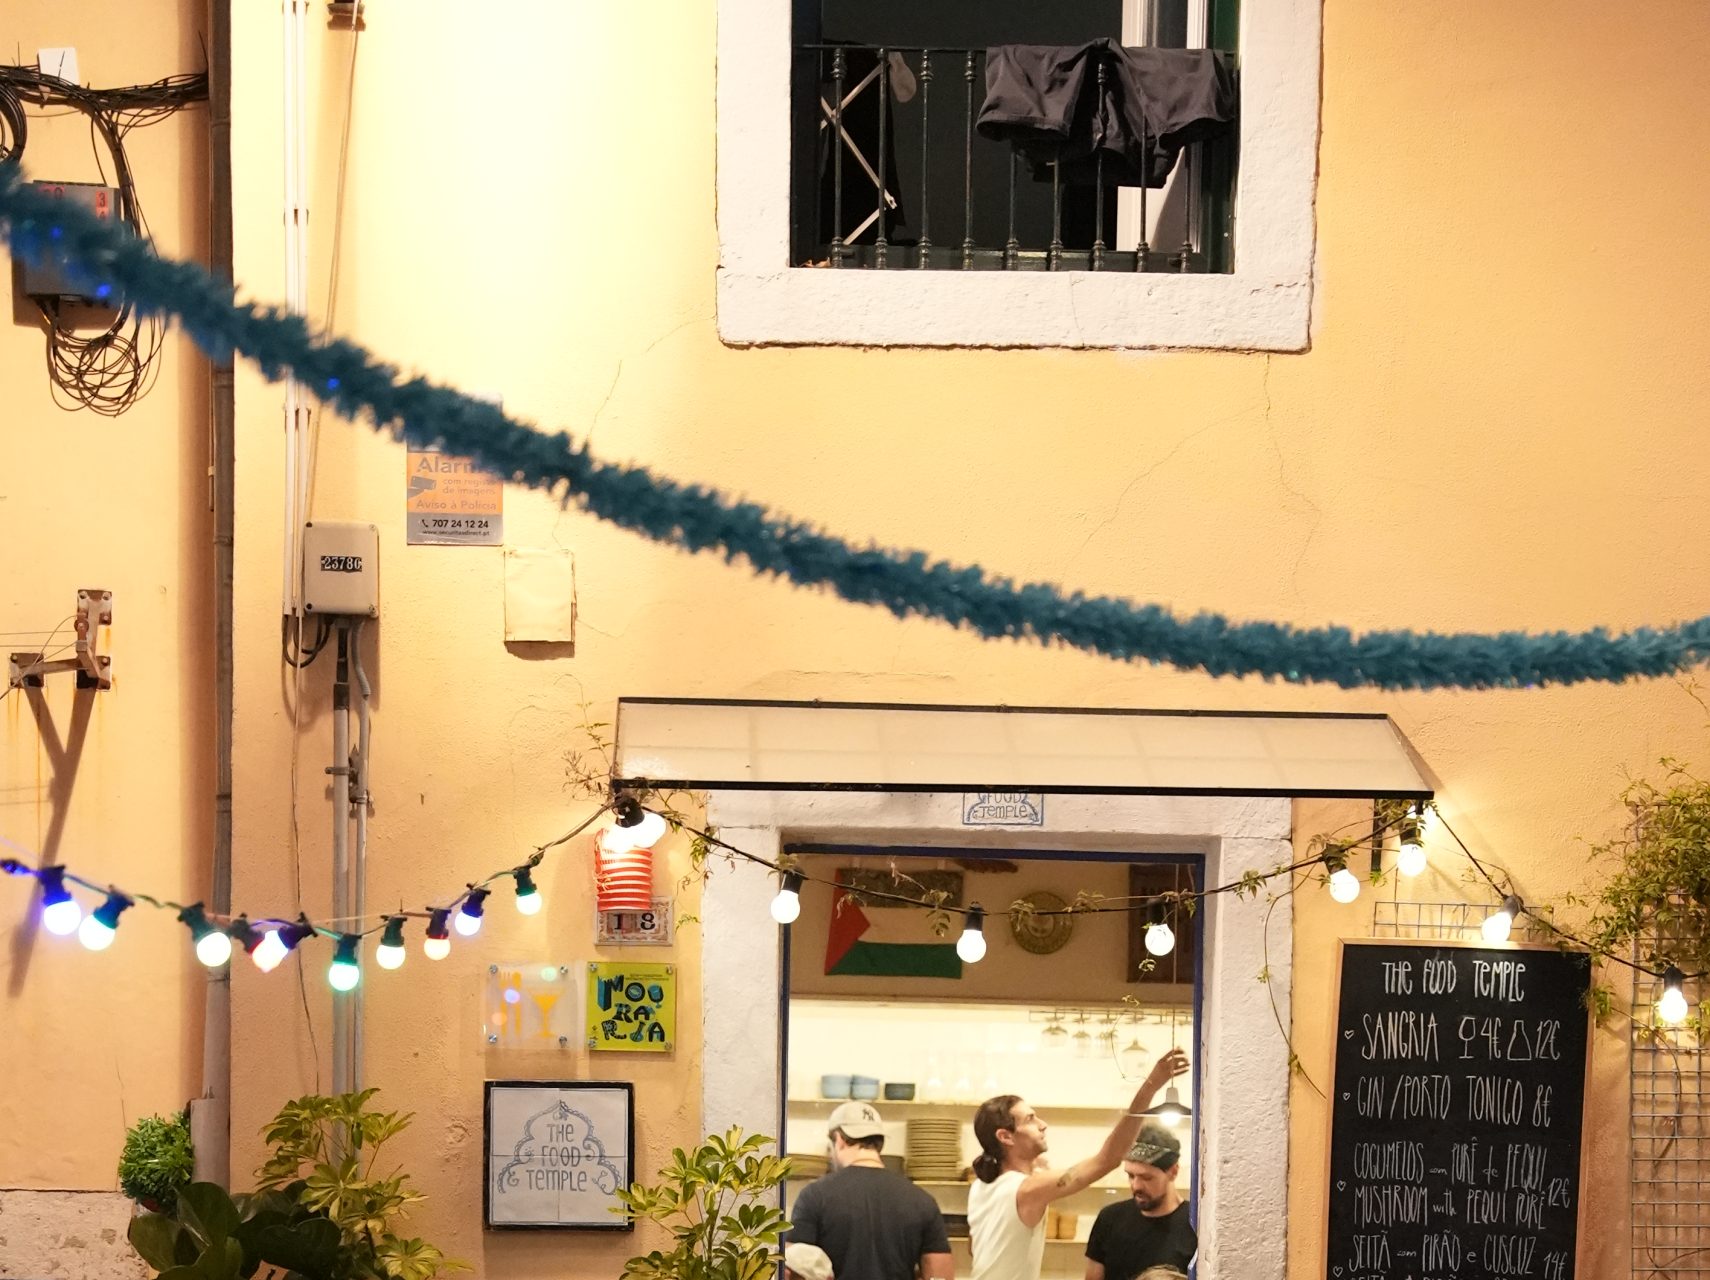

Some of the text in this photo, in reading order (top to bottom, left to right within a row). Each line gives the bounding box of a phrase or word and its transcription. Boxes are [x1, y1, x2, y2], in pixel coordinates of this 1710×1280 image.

[416, 500, 447, 509] Aviso
[432, 519, 489, 529] 707 24 12 24
[1361, 1010, 1561, 1063] SANGRIA 4€ 12€
[1357, 1075, 1385, 1120] GIN
[1465, 1075, 1523, 1126] TONICO
[1532, 1083, 1553, 1128] 8€
[541, 1145, 581, 1167] FOOD
[1354, 1136, 1547, 1193] COGUMELOS com PURÊ de PEQUI
[1354, 1184, 1428, 1229] MUSHROOM
[1432, 1188, 1457, 1217] with
[1466, 1188, 1506, 1225] PEQUI
[1547, 1177, 1571, 1209] 12€
[1348, 1229, 1391, 1273] SEITÃ
[1422, 1229, 1461, 1272] PIRÃO
[1466, 1250, 1477, 1263] e
[1483, 1233, 1537, 1275] CUSCUZ
